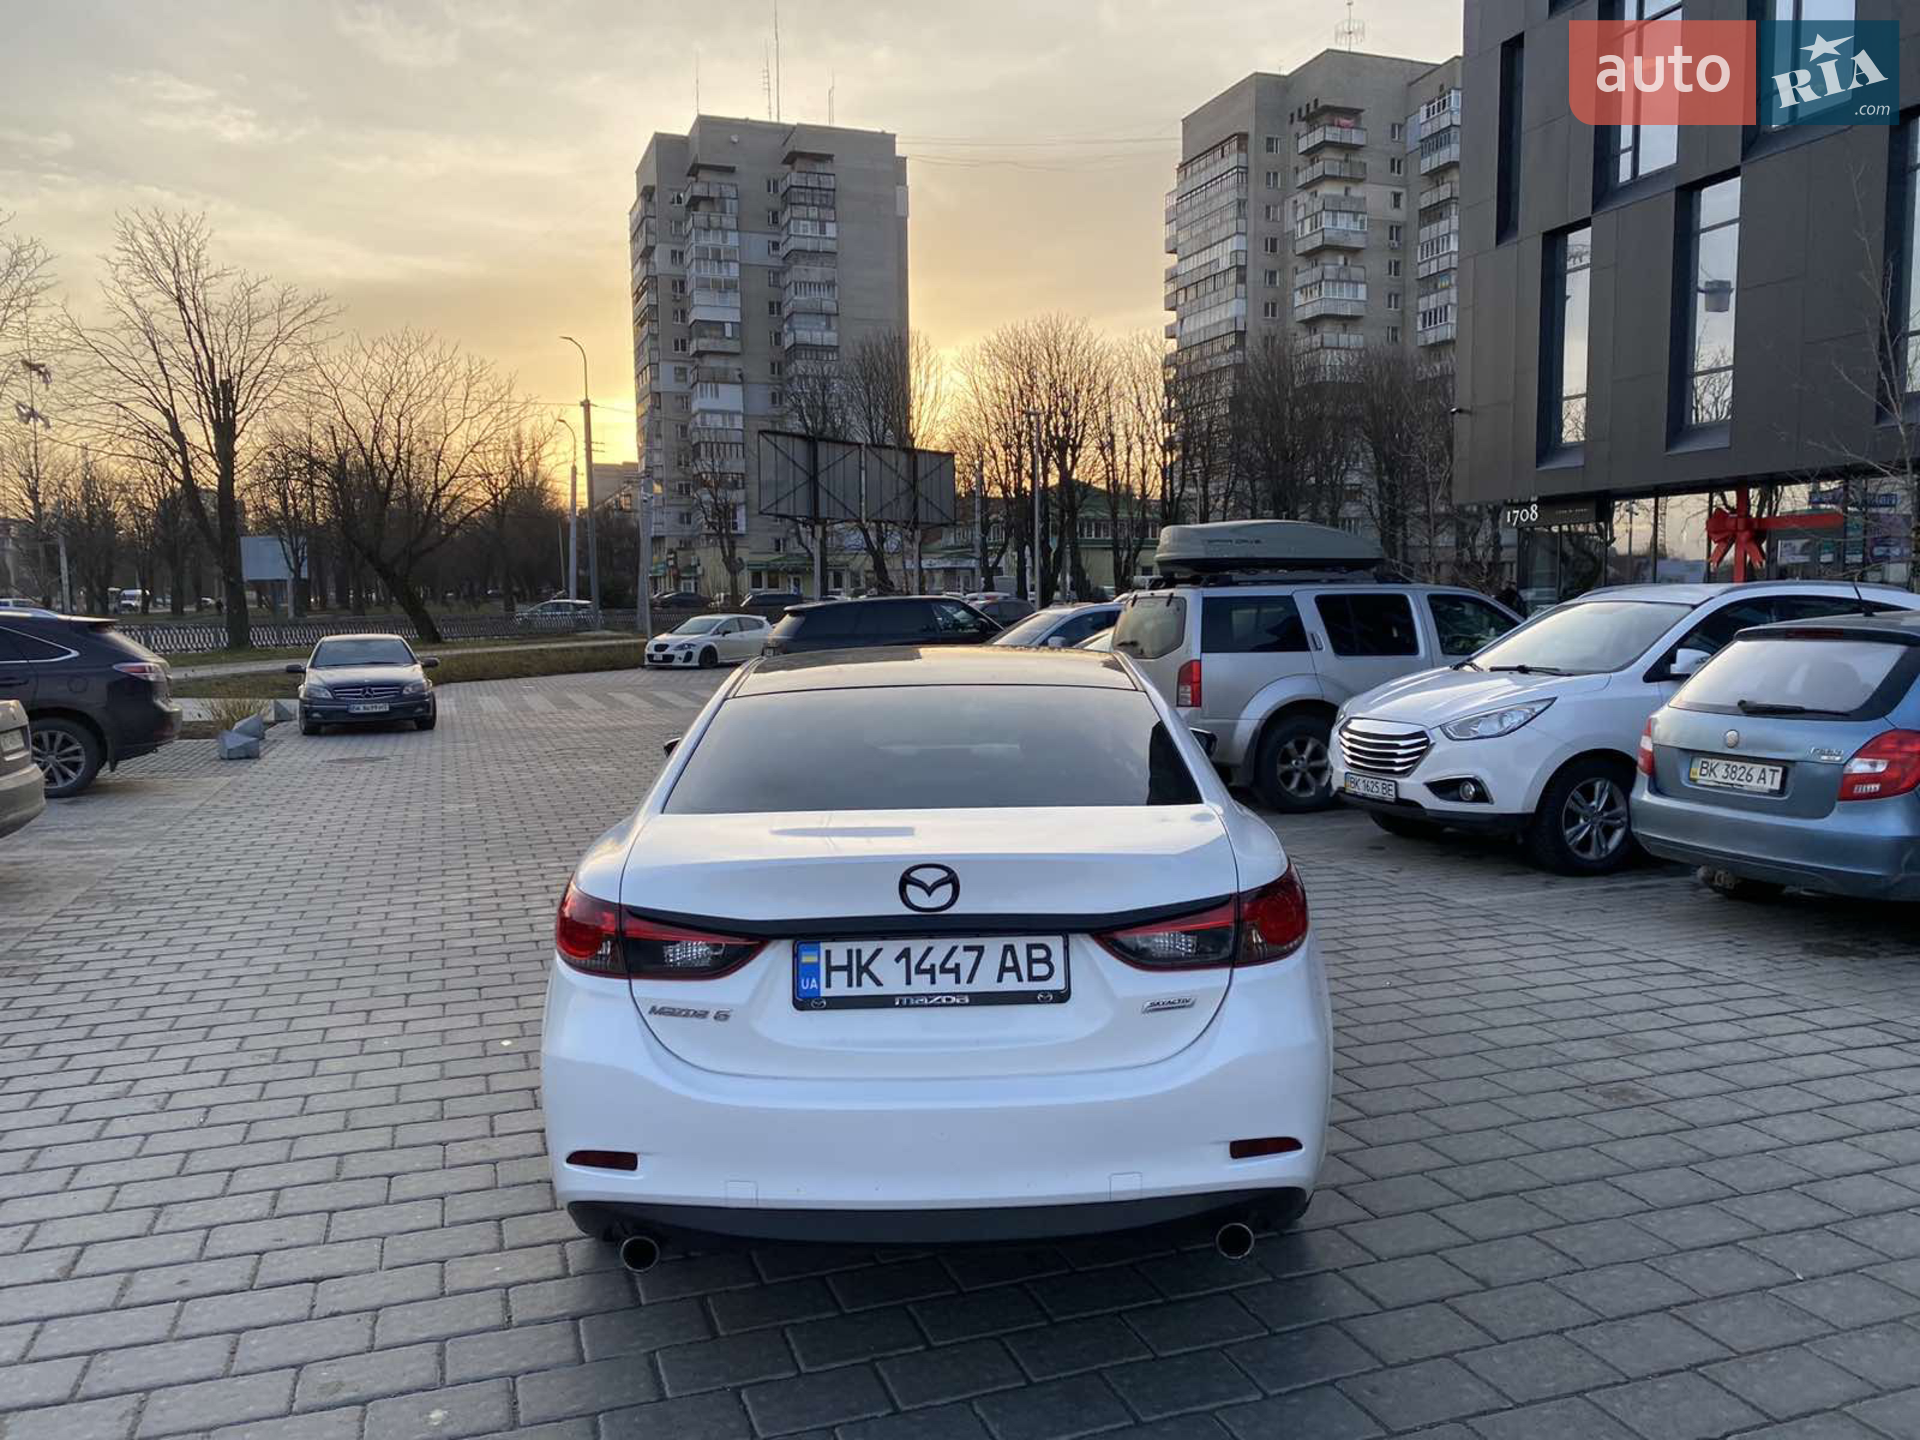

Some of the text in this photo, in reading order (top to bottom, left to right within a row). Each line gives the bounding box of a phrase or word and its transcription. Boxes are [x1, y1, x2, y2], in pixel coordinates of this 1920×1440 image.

[1506, 503, 1539, 527] 1708
[1699, 760, 1780, 786] BK 3826 AT
[1349, 776, 1394, 797] BK 1625 BE
[824, 942, 1055, 989] HK 1447 AB
[801, 977, 818, 990] UA
[713, 1009, 731, 1022] 6
